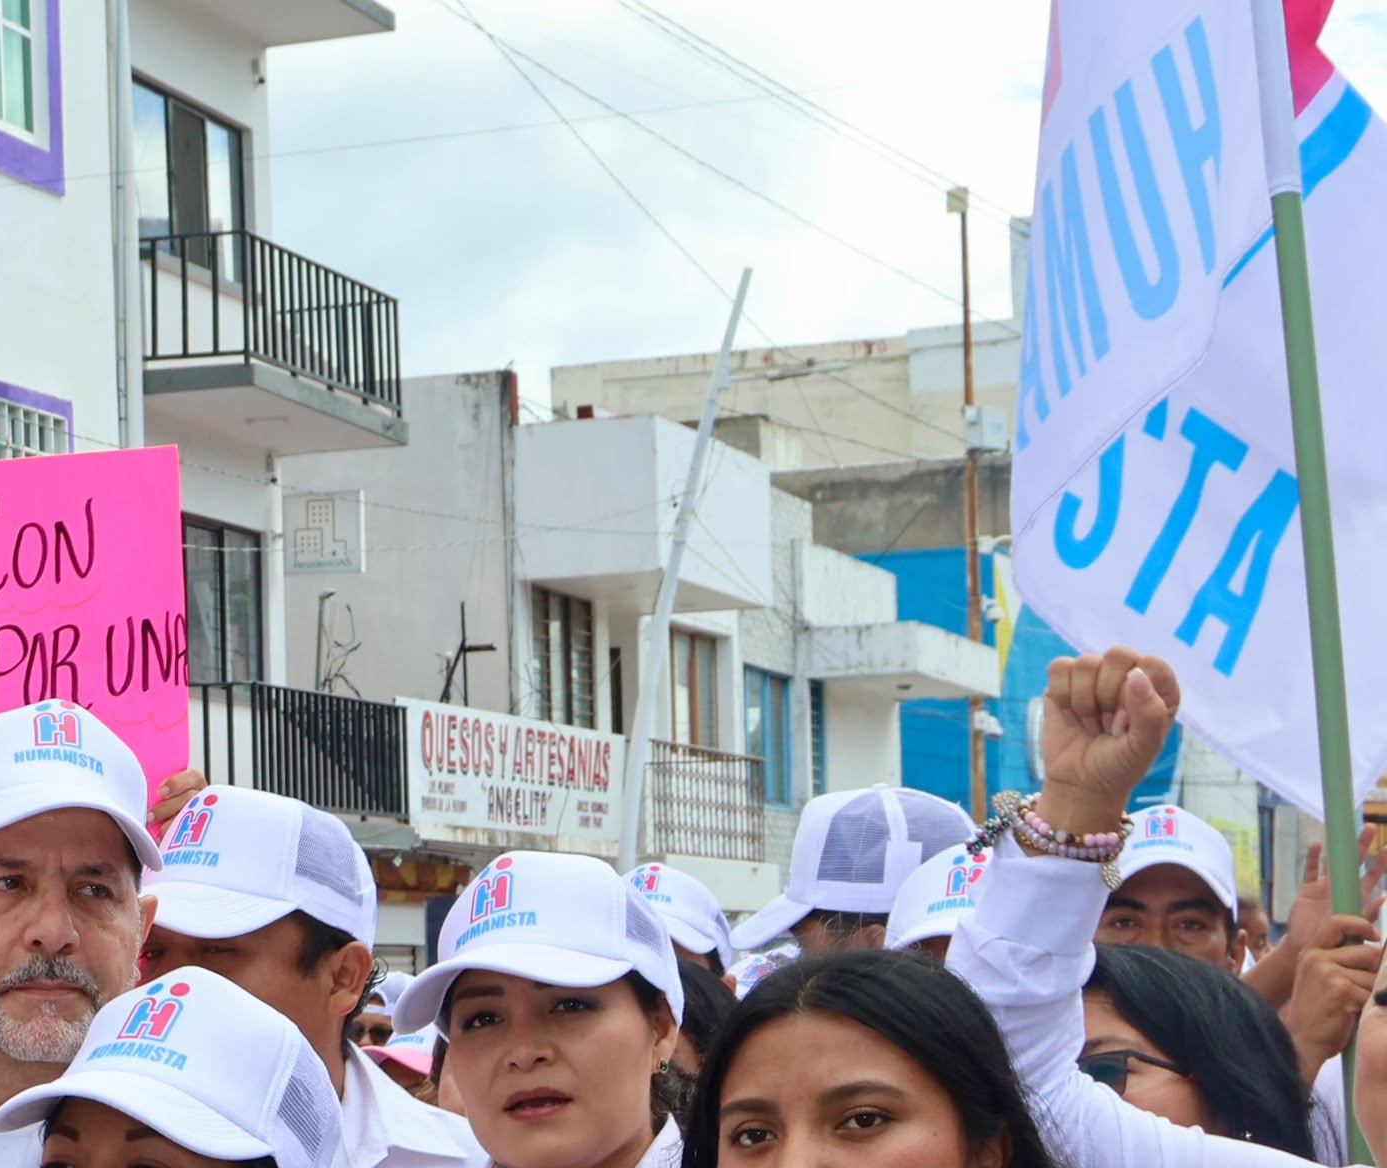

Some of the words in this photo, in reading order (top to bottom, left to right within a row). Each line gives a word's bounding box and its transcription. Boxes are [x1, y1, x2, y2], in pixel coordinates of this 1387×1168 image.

[105, 610, 189, 697] UNA
[13, 747, 104, 777] HUMANISTA
[420, 709, 495, 777] QUESOS
[499, 722, 509, 779] Y
[512, 726, 612, 793] ARTESANIAS
[454, 911, 537, 952] HUMANISTA
[85, 1041, 188, 1072] HUMANISTA
